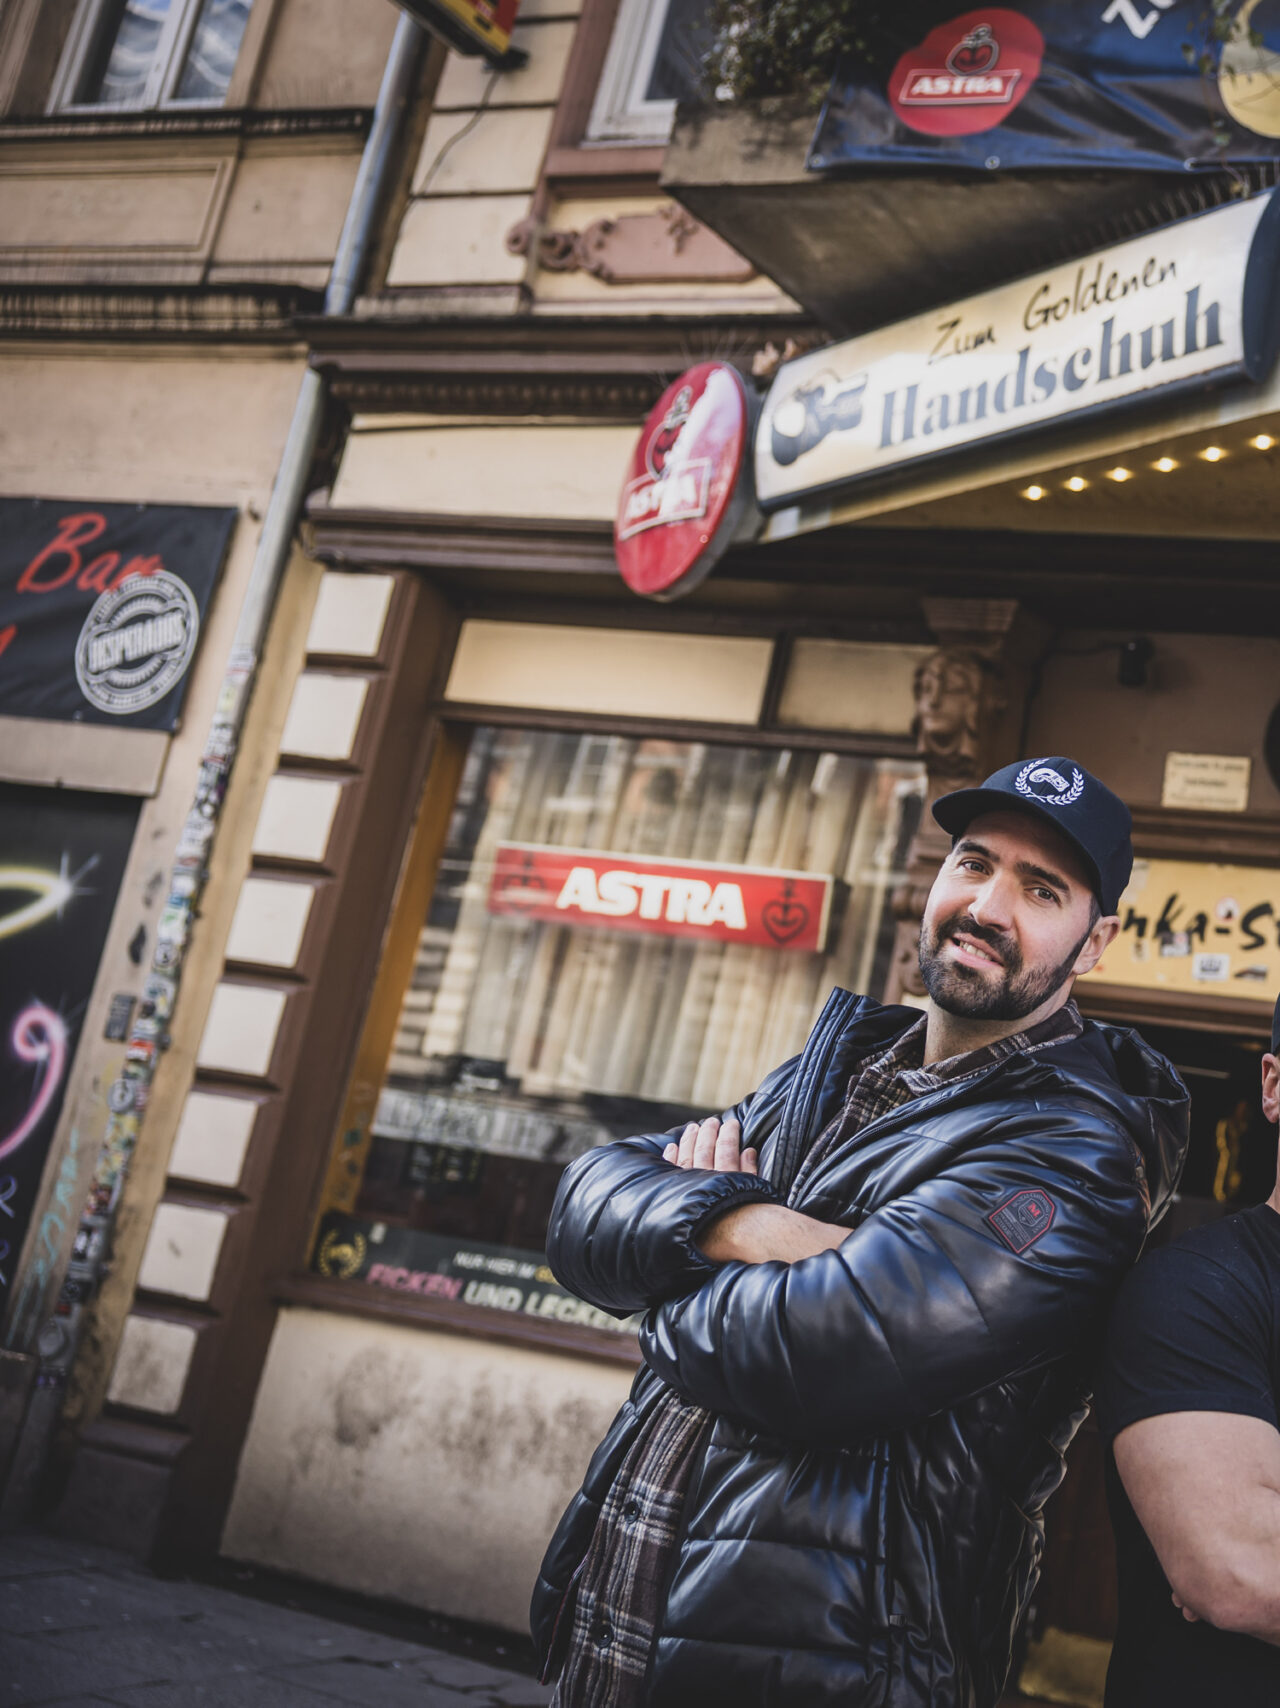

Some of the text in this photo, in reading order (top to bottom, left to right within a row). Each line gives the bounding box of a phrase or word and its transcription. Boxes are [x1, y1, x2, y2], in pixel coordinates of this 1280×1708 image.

[911, 76, 1003, 95] ASTRA
[926, 255, 1178, 366] Zum Goldenen
[878, 286, 1224, 450] Handschuh
[556, 866, 748, 930] ASTRA
[463, 1280, 523, 1313] UND
